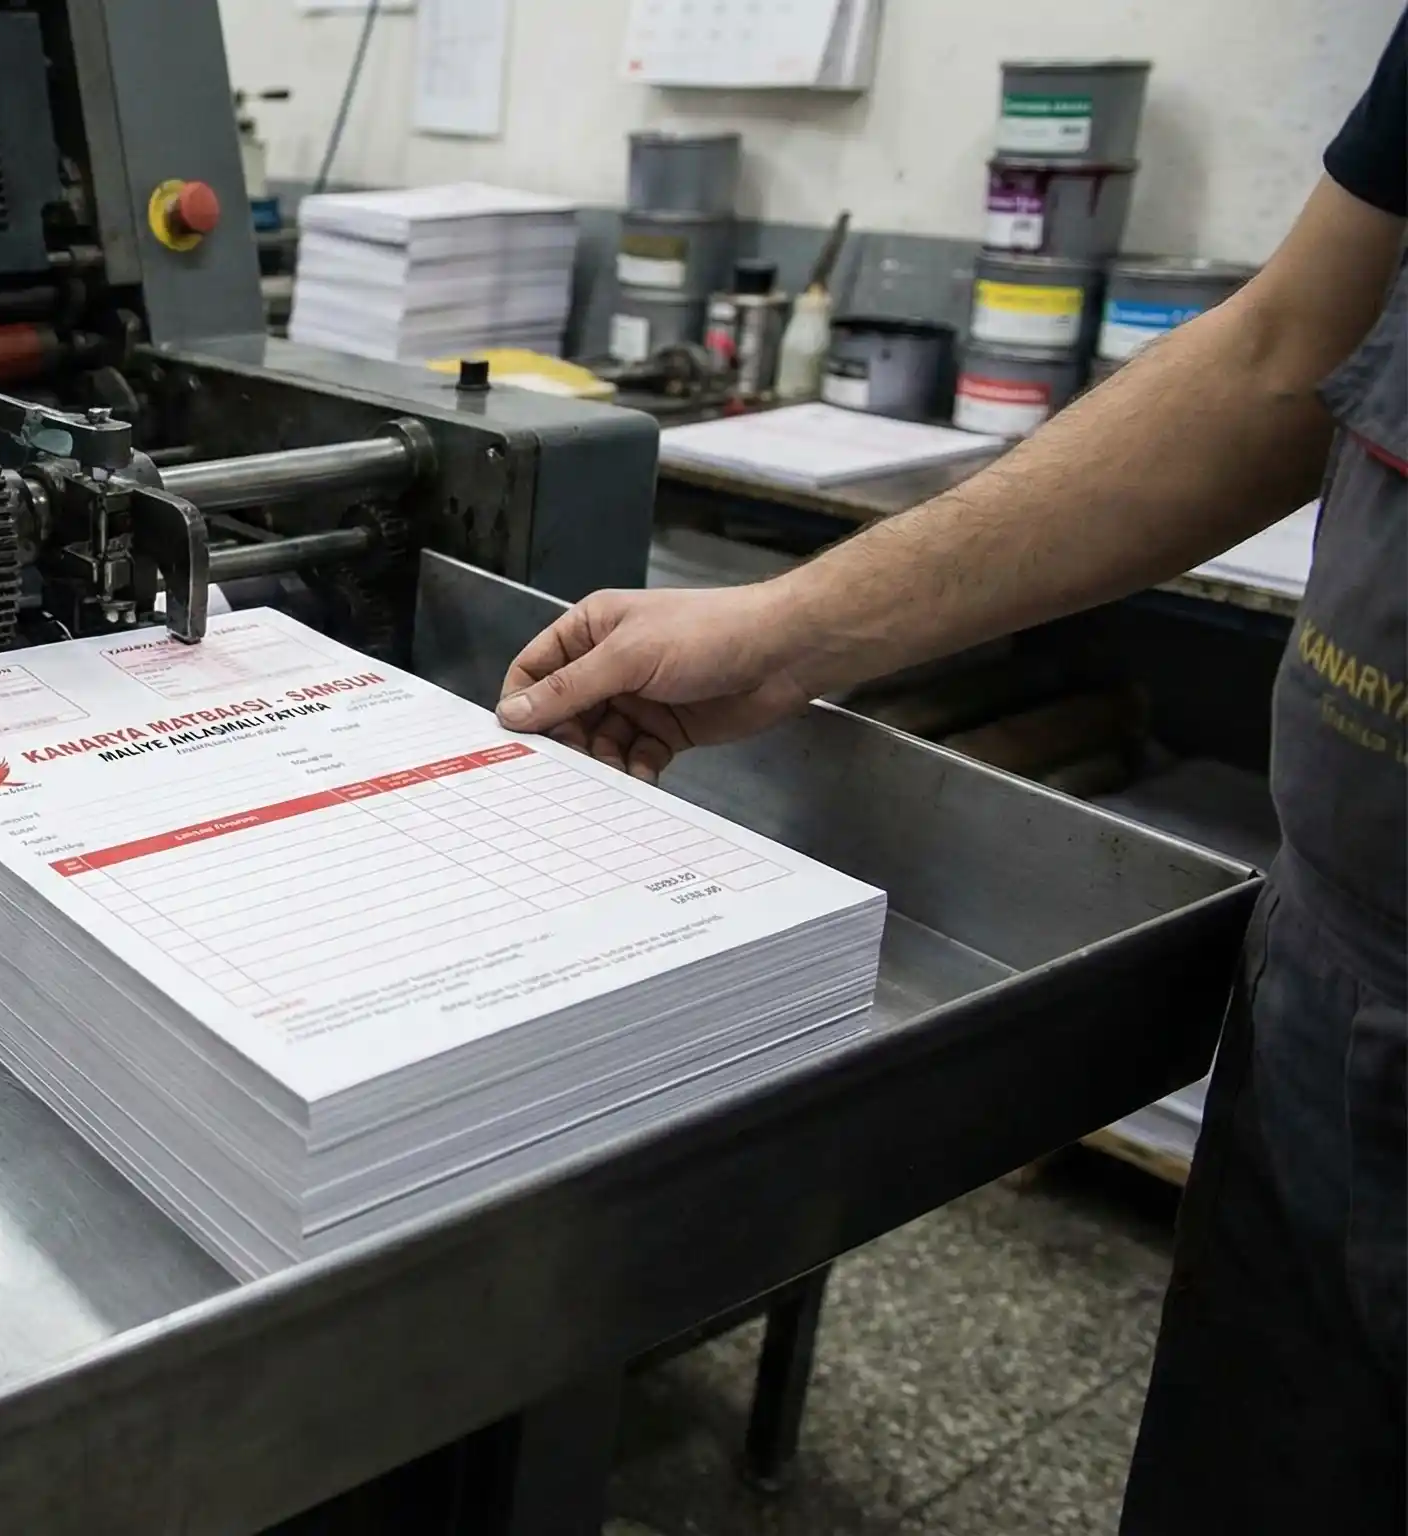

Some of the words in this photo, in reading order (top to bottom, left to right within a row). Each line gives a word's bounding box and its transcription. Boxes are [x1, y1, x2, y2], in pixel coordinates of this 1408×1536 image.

[21, 726, 149, 764] KANARYA
[145, 697, 273, 734] MATBAASI
[285, 672, 386, 702] SAMSUN
[98, 739, 168, 763] MALİYE
